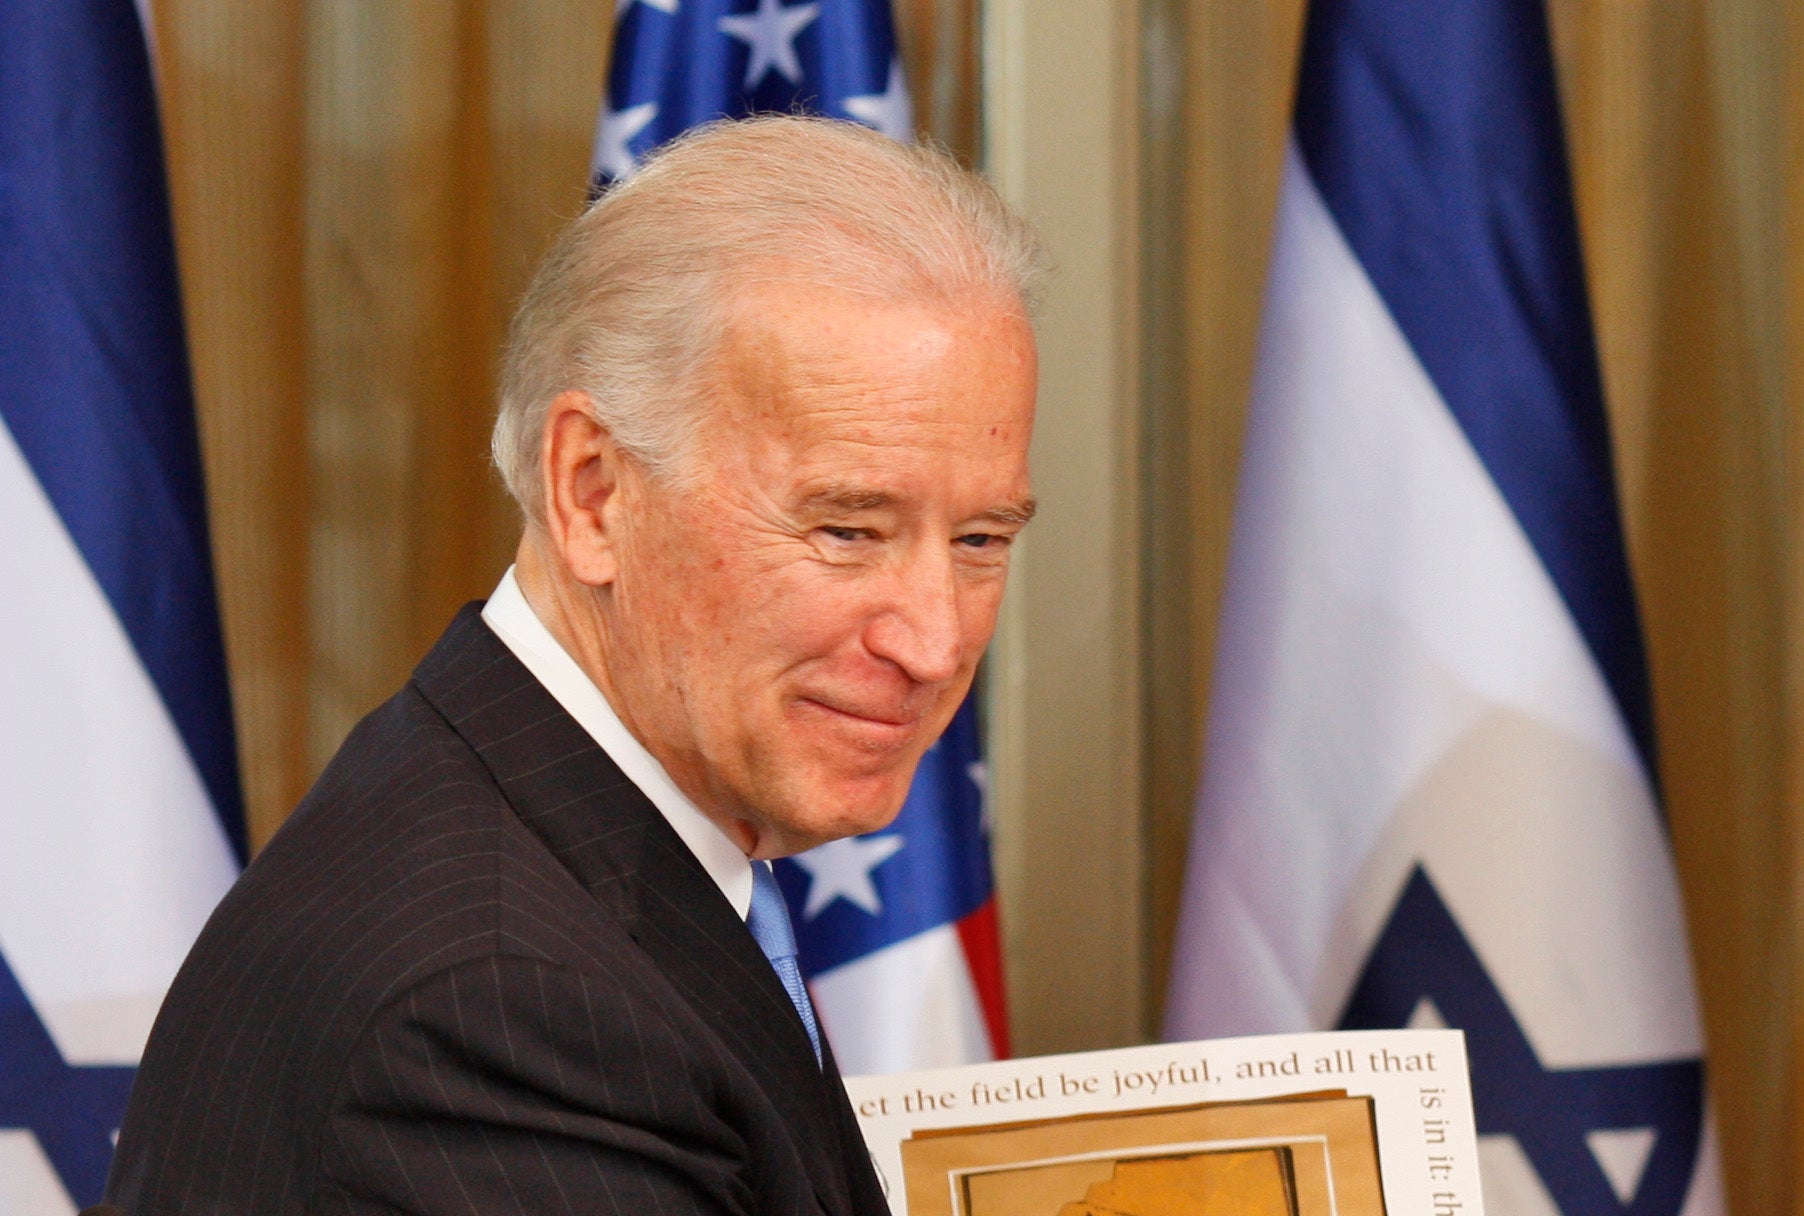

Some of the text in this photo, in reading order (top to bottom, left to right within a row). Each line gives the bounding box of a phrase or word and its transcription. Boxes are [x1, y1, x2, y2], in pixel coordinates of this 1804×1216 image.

[855, 1047, 1438, 1119] et the field be joyful, and all that
[1419, 1087, 1446, 1109] is
[1424, 1120, 1450, 1144] in
[1428, 1156, 1454, 1180] it:
